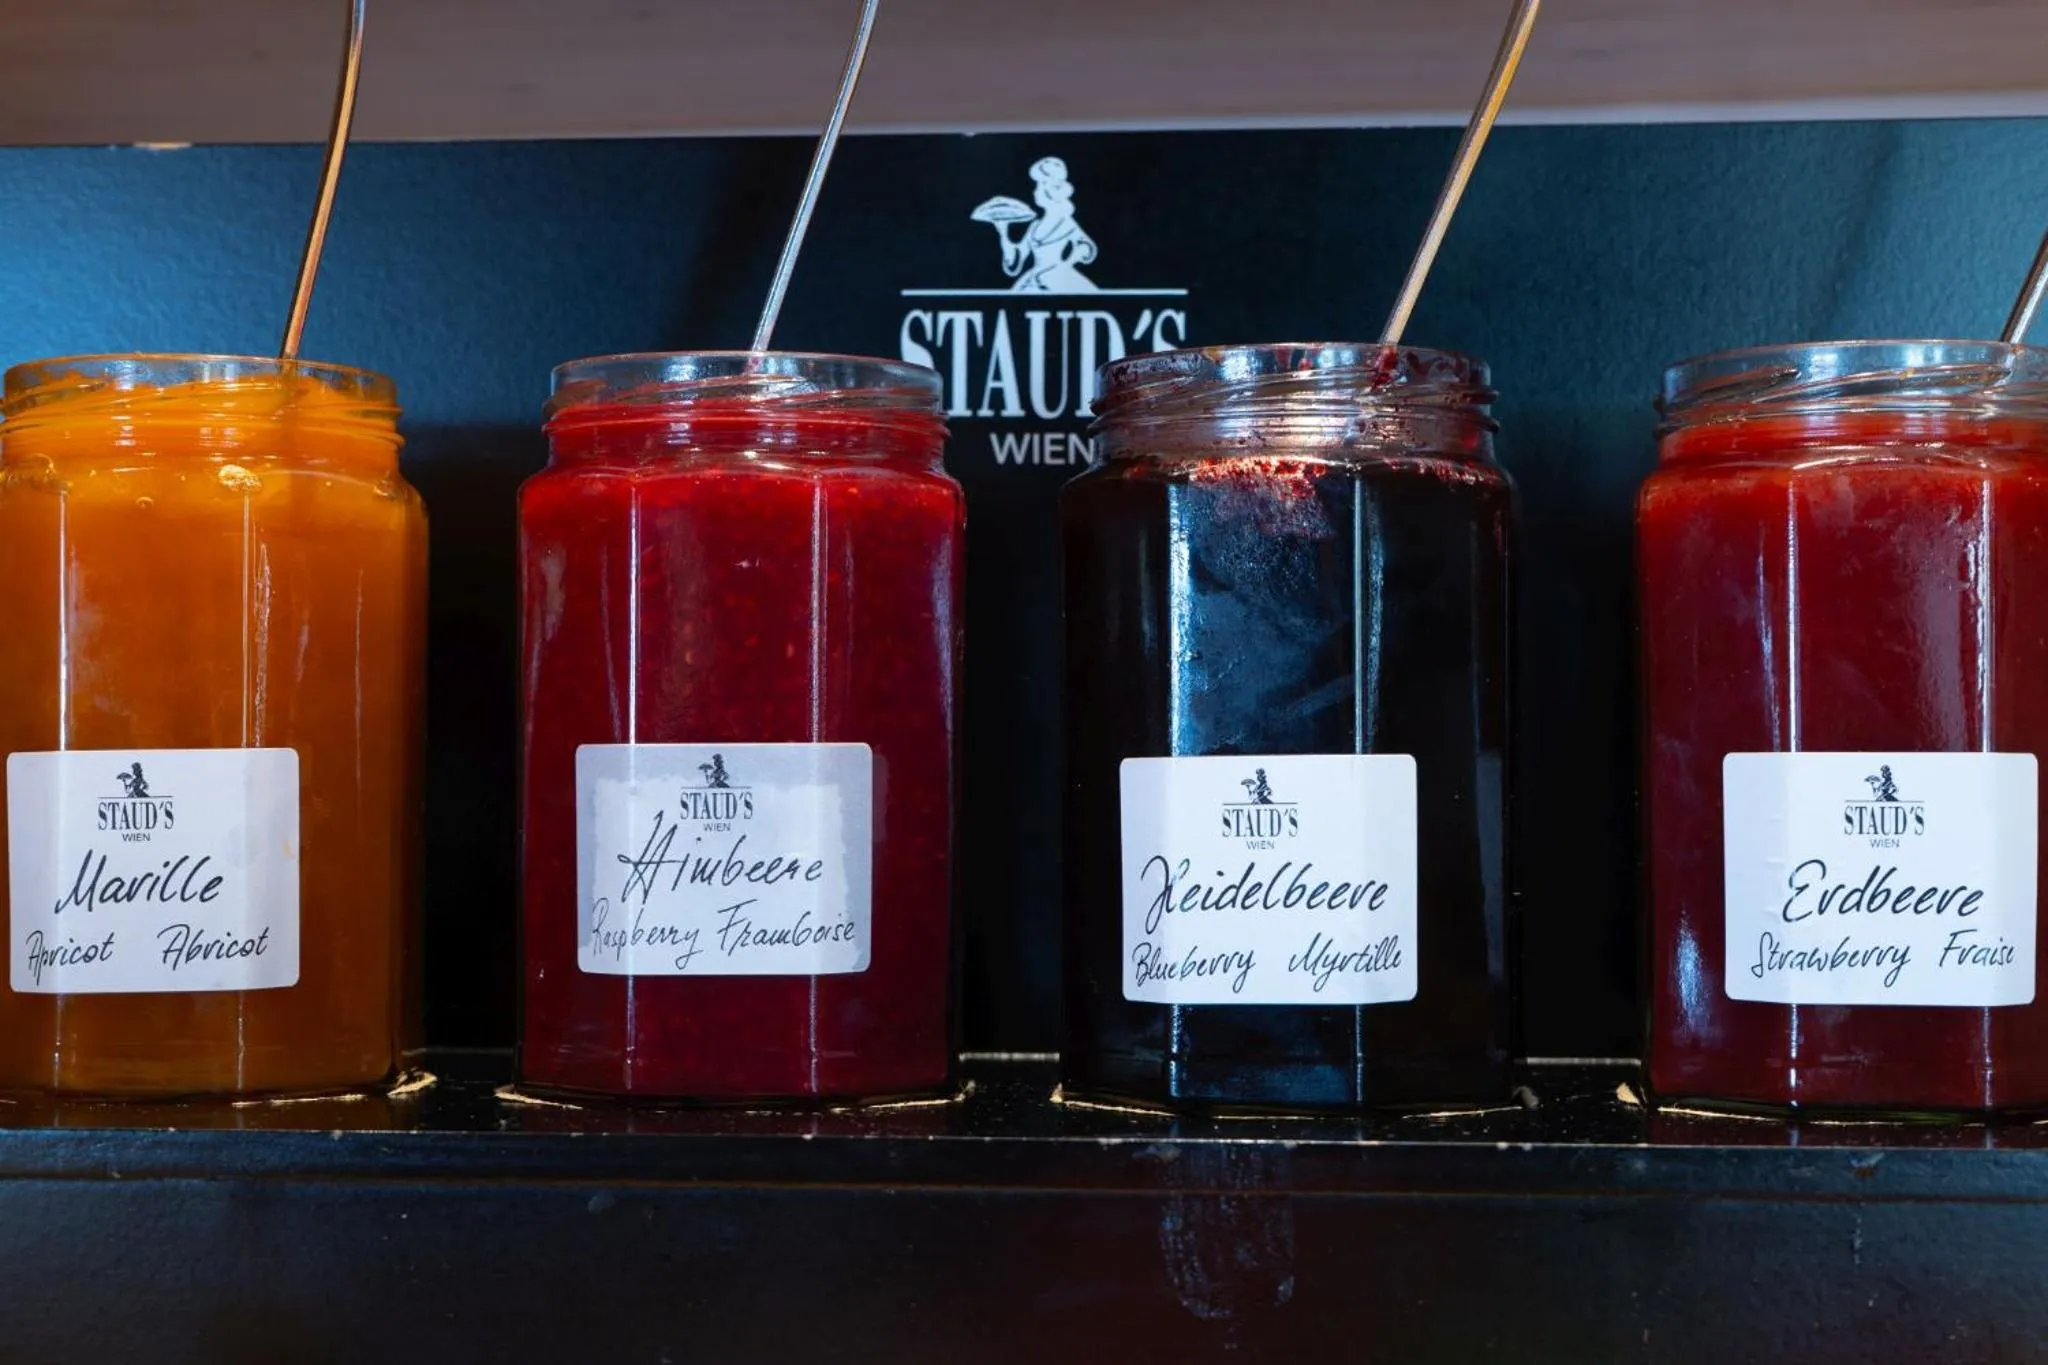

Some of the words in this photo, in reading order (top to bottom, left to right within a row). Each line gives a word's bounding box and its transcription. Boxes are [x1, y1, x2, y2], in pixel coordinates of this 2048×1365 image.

[990, 432, 1095, 465] WIEN
[98, 800, 174, 830] STAUD'S
[680, 791, 753, 820] STAUD'S
[1844, 805, 1925, 836] STAUD'S
[121, 833, 151, 842] WIEN
[703, 822, 731, 832] WIEN
[1222, 807, 1298, 837] STAUD'S
[617, 810, 823, 904] Himbeere
[1246, 840, 1275, 850] WIEN
[1870, 838, 1900, 848] WIEN
[1140, 855, 1388, 935] Heidelbeere
[1782, 859, 1983, 923] Erdbeere
[592, 897, 703, 970] Raspberry
[717, 899, 855, 957] Framboise
[26, 930, 114, 986] Apricot
[157, 923, 270, 971] Abricot
[1132, 942, 1256, 994] Blueberry
[1288, 932, 1401, 992] Myrtille
[1751, 931, 1911, 988] Strawberry
